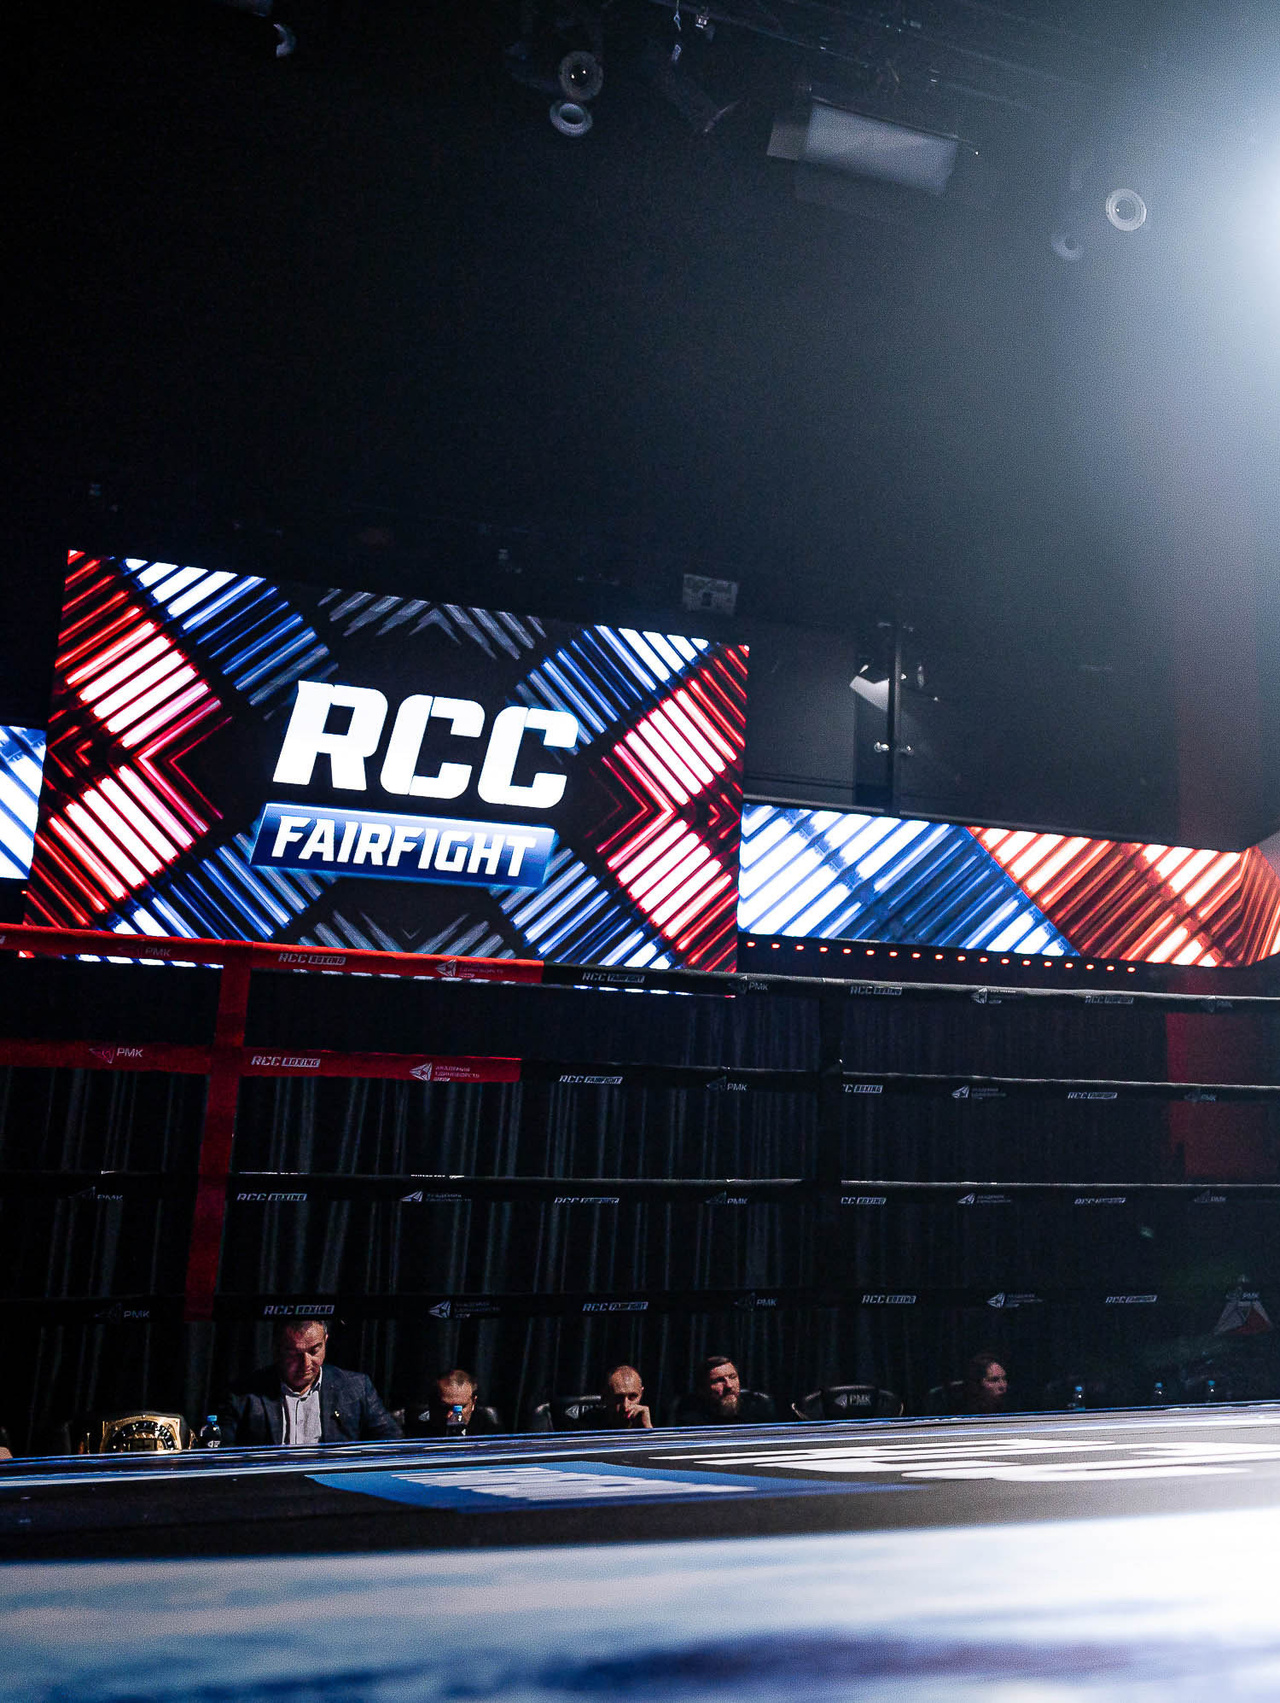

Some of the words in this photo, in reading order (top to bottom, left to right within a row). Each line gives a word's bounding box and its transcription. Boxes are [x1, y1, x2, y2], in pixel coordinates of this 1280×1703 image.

[273, 680, 579, 809] RCC
[271, 816, 537, 877] FAIRFIGHT
[278, 953, 308, 964] RCC
[309, 955, 346, 966] BOXING
[251, 1055, 281, 1066] RCC
[282, 1058, 320, 1068] BOXING
[236, 1193, 267, 1202] RCC
[263, 1305, 295, 1316] RCC
